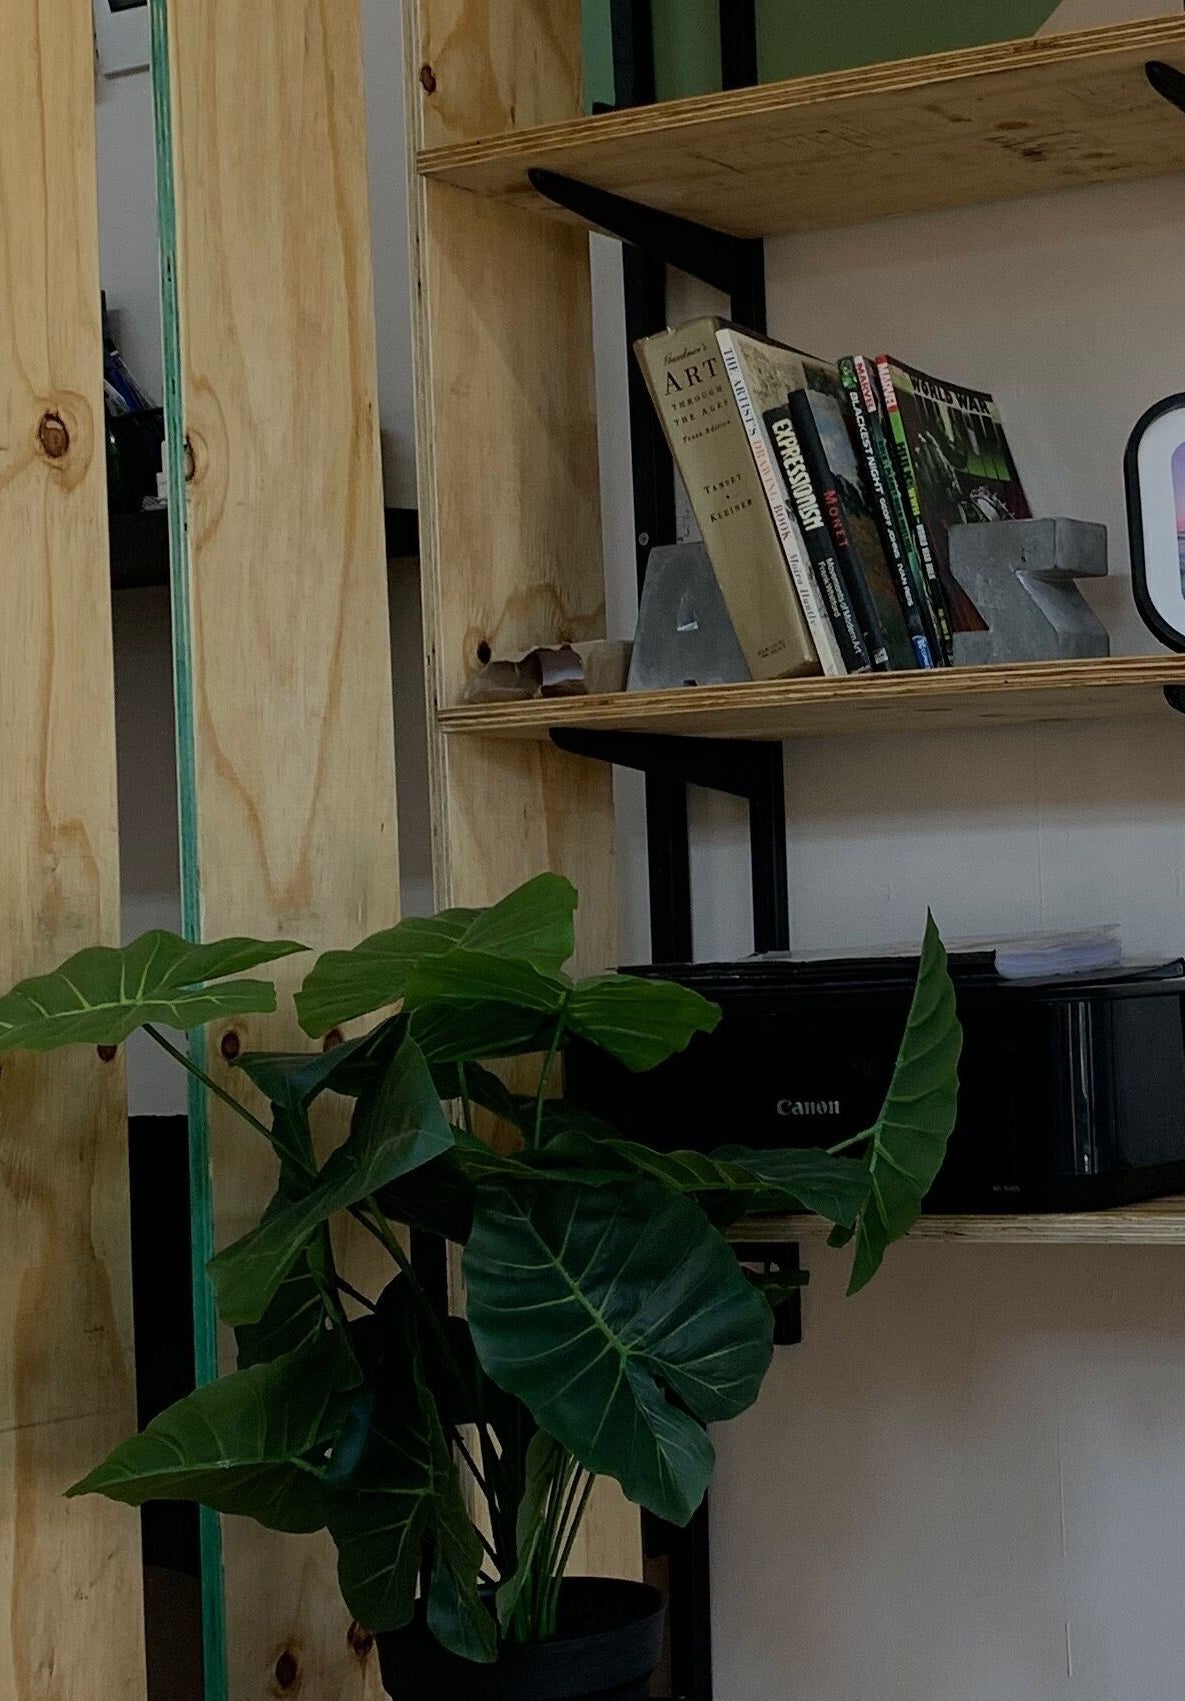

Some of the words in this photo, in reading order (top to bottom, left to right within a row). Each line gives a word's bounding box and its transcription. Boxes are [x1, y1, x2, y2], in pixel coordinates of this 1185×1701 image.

[664, 357, 718, 396] ART
[856, 362, 874, 409] MARVEL
[877, 362, 898, 408] MARVEL
[909, 376, 957, 405] WORLD
[954, 393, 991, 418] WAR
[849, 391, 873, 455] BLACKEST
[866, 456, 884, 495] NIGHT
[771, 418, 825, 531] EXPRESSIONISM
[772, 504, 792, 541] BOOK
[823, 490, 849, 547] MONET
[852, 640, 862, 654] Art
[776, 1099, 841, 1116] Canon
